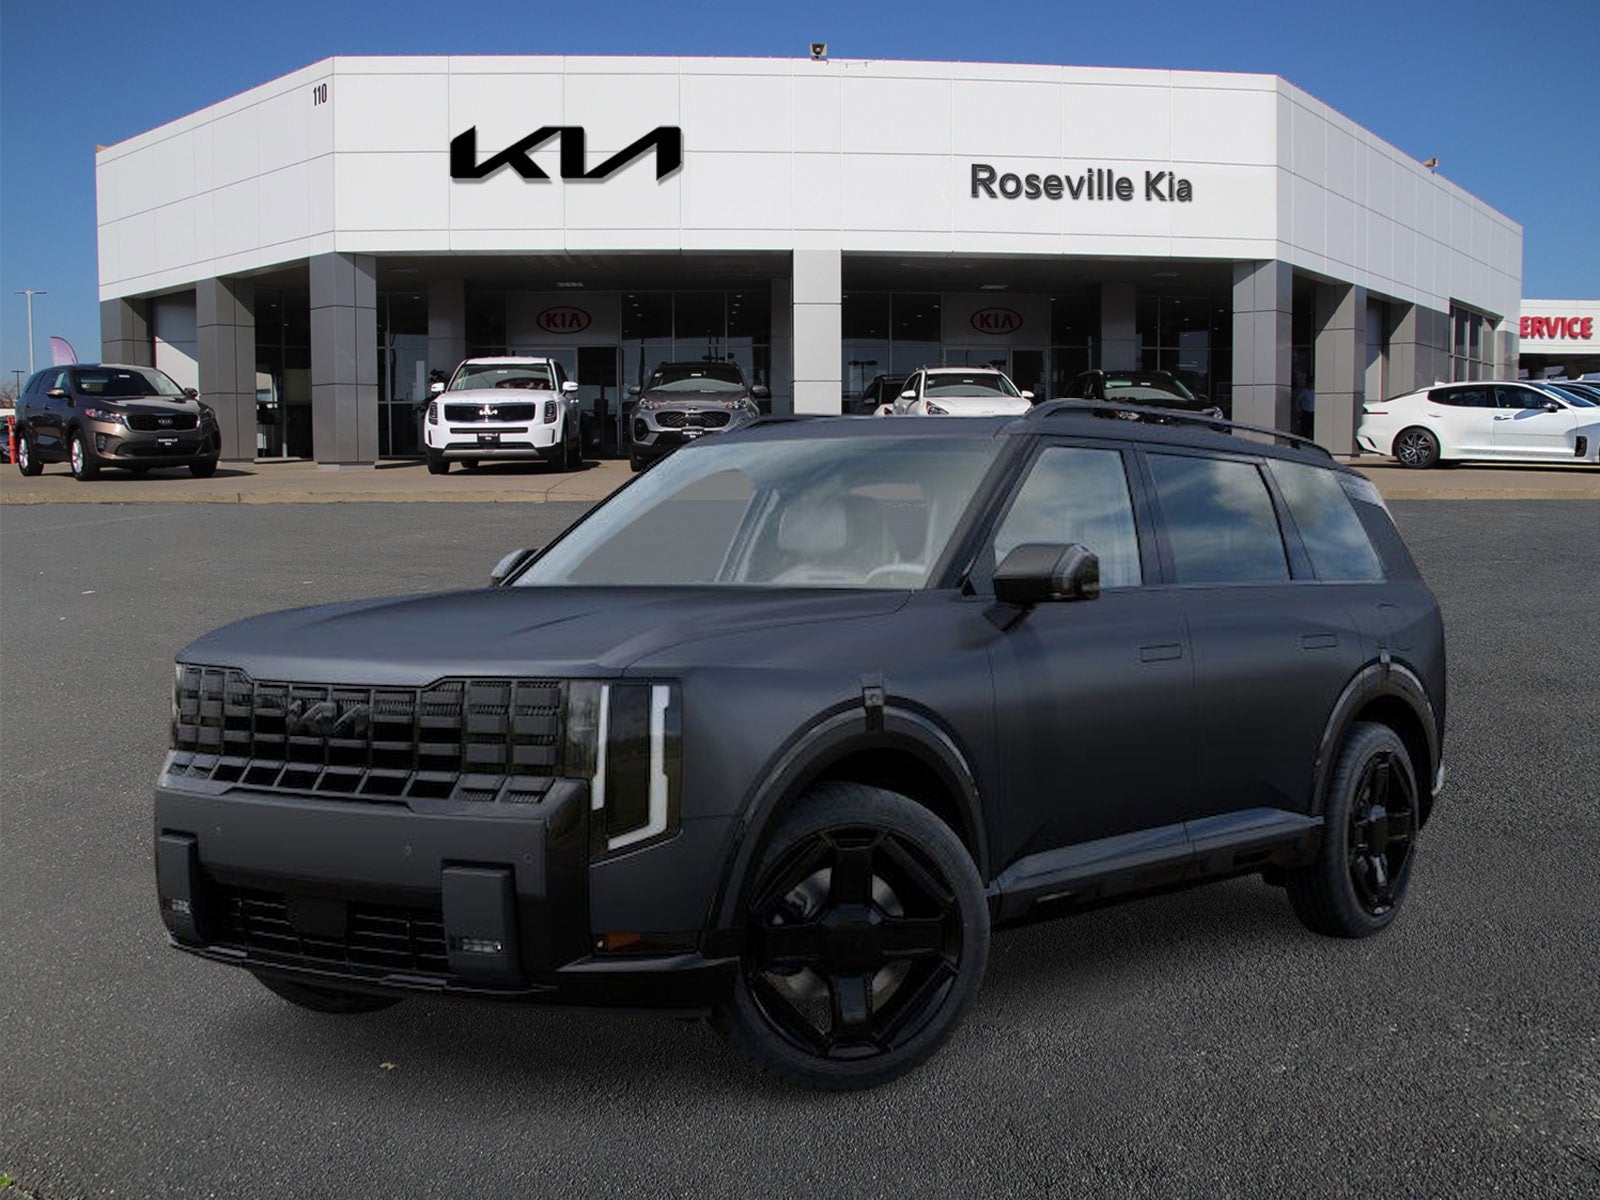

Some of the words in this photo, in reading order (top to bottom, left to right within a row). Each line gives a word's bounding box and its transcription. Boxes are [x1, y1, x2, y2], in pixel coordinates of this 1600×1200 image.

[313, 83, 328, 106] 110
[970, 163, 1133, 201] Roseville
[1145, 170, 1193, 202] Kia
[546, 312, 582, 328] KIA
[980, 312, 1014, 328] KIA
[1519, 315, 1594, 340] ERVICE
